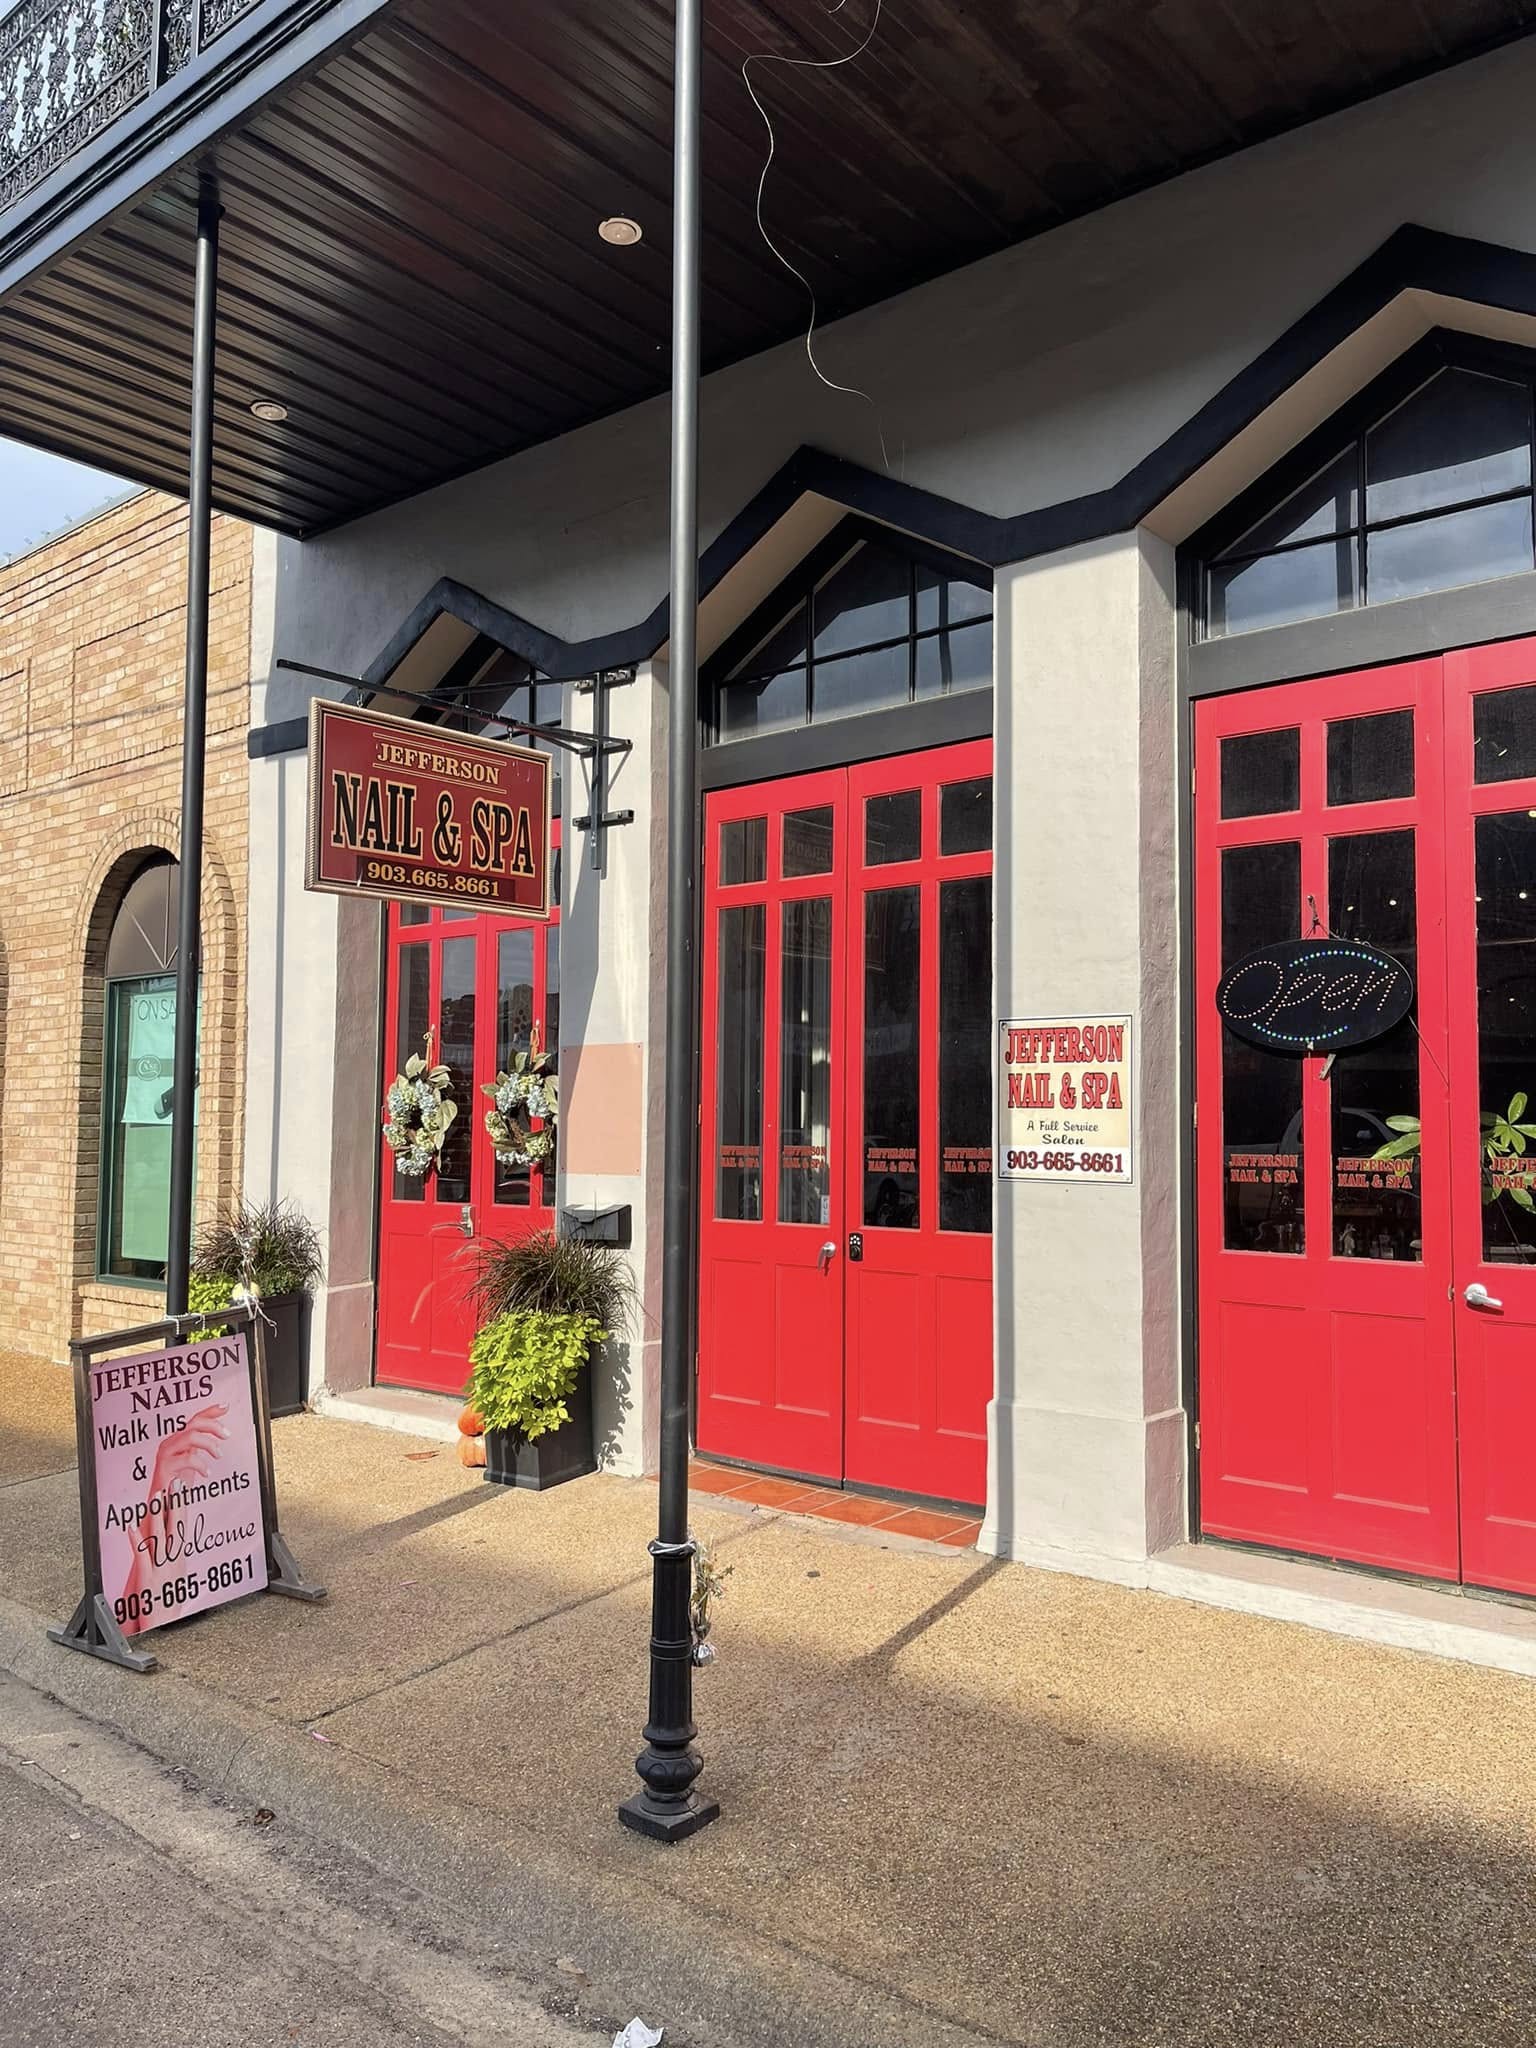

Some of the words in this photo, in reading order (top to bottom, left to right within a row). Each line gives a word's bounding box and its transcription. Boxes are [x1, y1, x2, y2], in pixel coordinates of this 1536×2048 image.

[377, 743, 500, 785] JEFFERSON
[331, 769, 423, 859] NAIL
[432, 790, 462, 866] &
[470, 797, 535, 878] SPA
[367, 862, 501, 898] 903.665.8661
[1222, 960, 1398, 1025] Open
[1005, 1025, 1124, 1064] JEFFERSON
[1008, 1073, 1054, 1108] NAIL
[1060, 1072, 1076, 1109] &
[1082, 1072, 1123, 1109] SPA
[1027, 1120, 1035, 1131] A
[1040, 1120, 1059, 1131] Full
[1063, 1120, 1099, 1132] Service
[1042, 1134, 1085, 1145] Salon
[943, 1147, 992, 1159] JEFFERSO
[1007, 1151, 1124, 1173] 903-665-8661
[1229, 1154, 1298, 1168] JEFFERSON
[1336, 1158, 1413, 1172] JEFFERSON
[1489, 1156, 1536, 1171] JEFFE
[1230, 1169, 1259, 1183] NAIL
[1261, 1169, 1272, 1183] &
[1274, 1169, 1298, 1184] SPA
[1337, 1174, 1369, 1188] NAIL
[1371, 1174, 1383, 1188] &
[1385, 1174, 1413, 1190] SPA
[94, 1343, 241, 1402] JEFFERSON
[130, 1374, 214, 1414] NAILS
[98, 1418, 150, 1451] Walk
[156, 1413, 187, 1437] Ins
[132, 1456, 147, 1481] &
[105, 1471, 250, 1532] Appointments
[138, 1513, 256, 1567] Welcome
[114, 1554, 253, 1625] 903-665-8661
